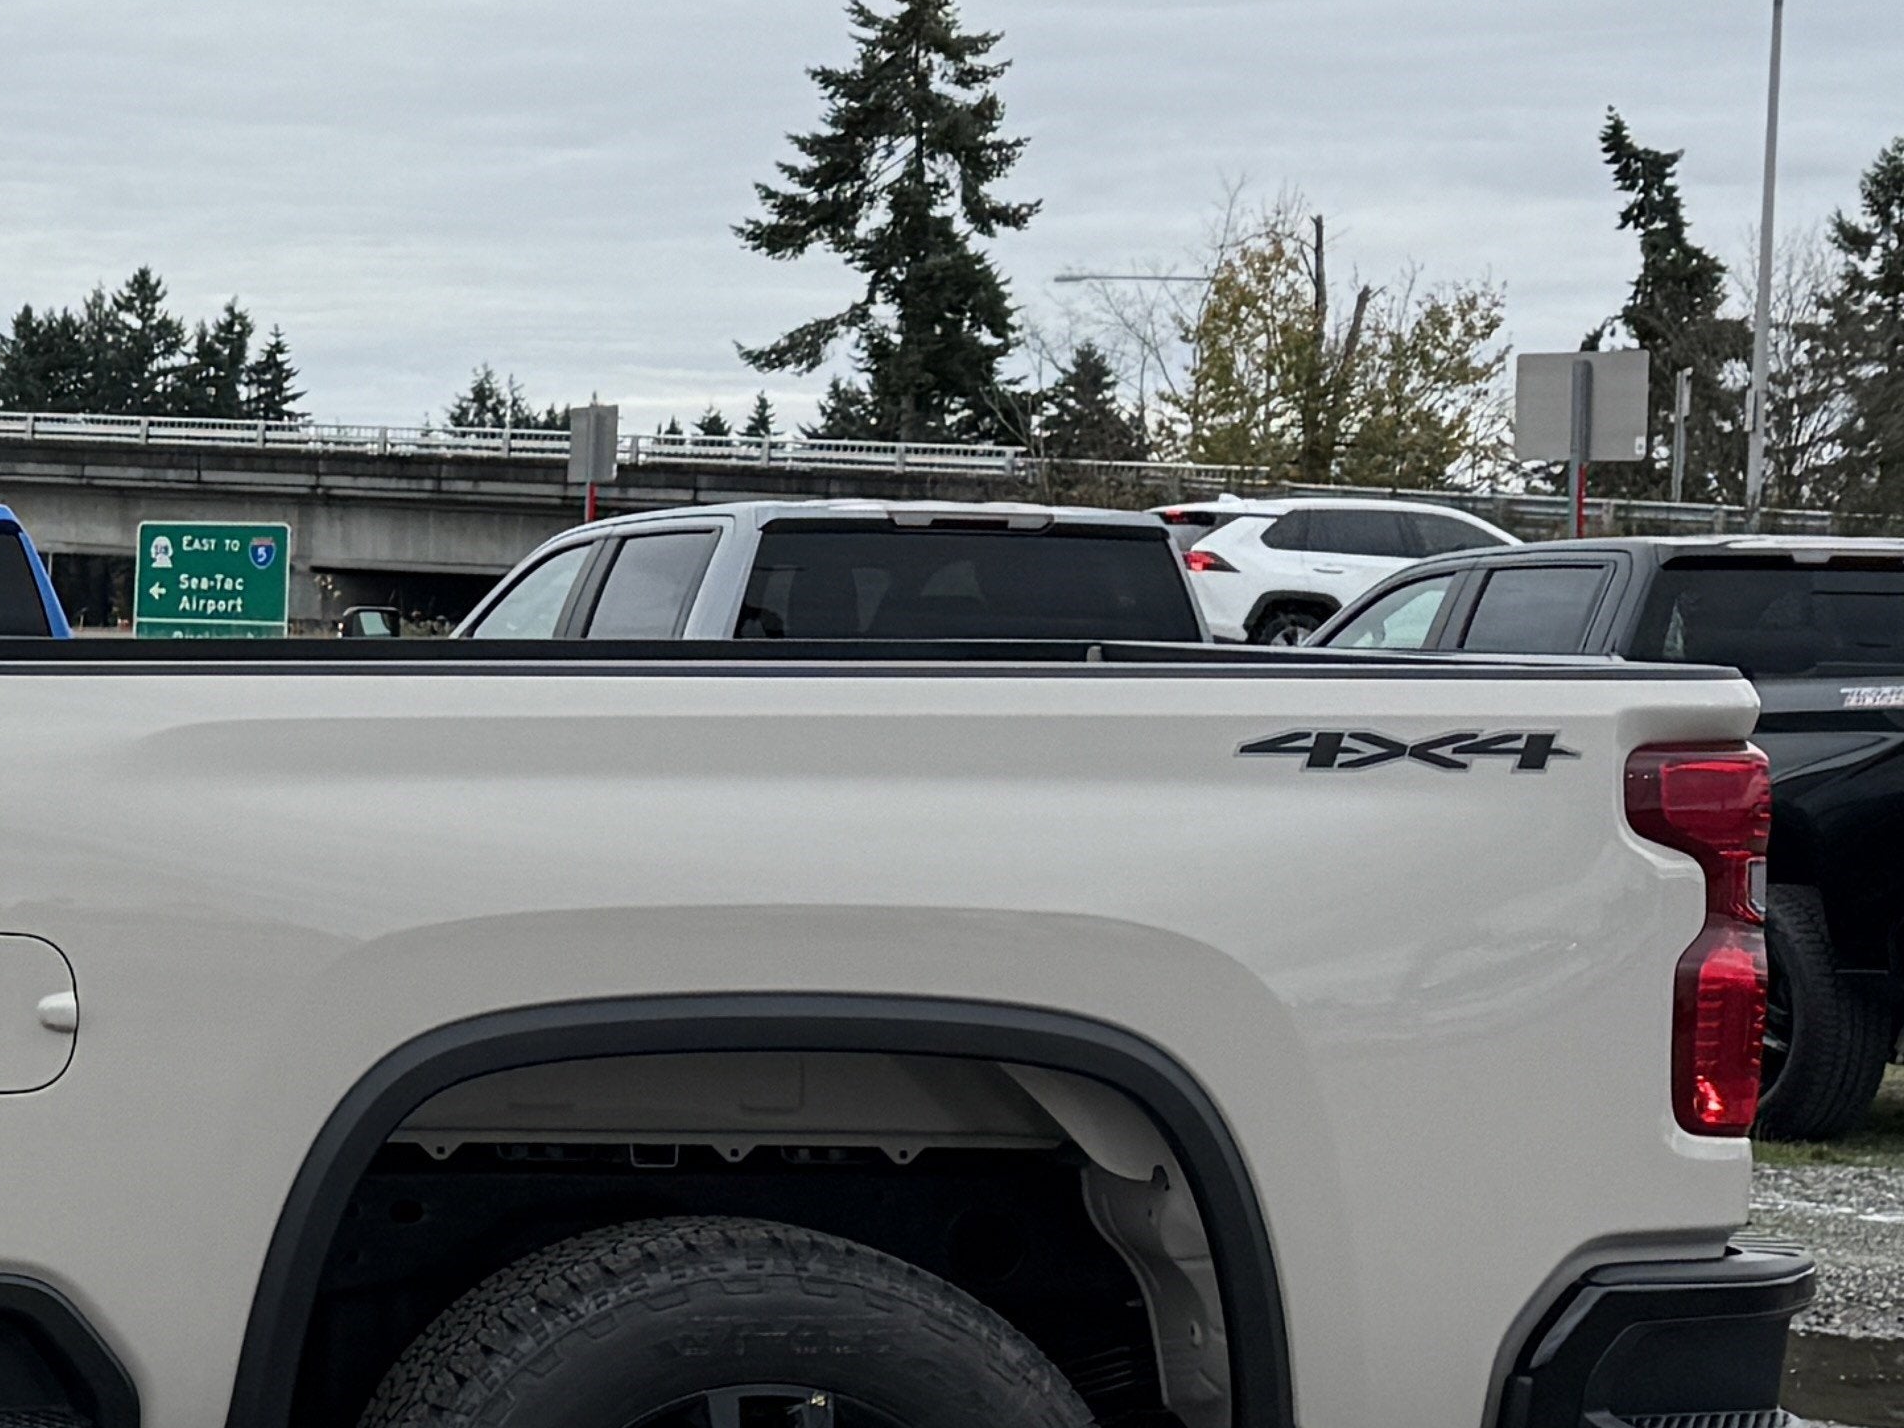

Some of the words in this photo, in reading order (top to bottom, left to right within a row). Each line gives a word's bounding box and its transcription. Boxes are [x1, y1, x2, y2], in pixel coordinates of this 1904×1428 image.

[257, 546, 267, 563] 5
[179, 573, 244, 591] Sea-Tac
[178, 595, 243, 614] Airport
